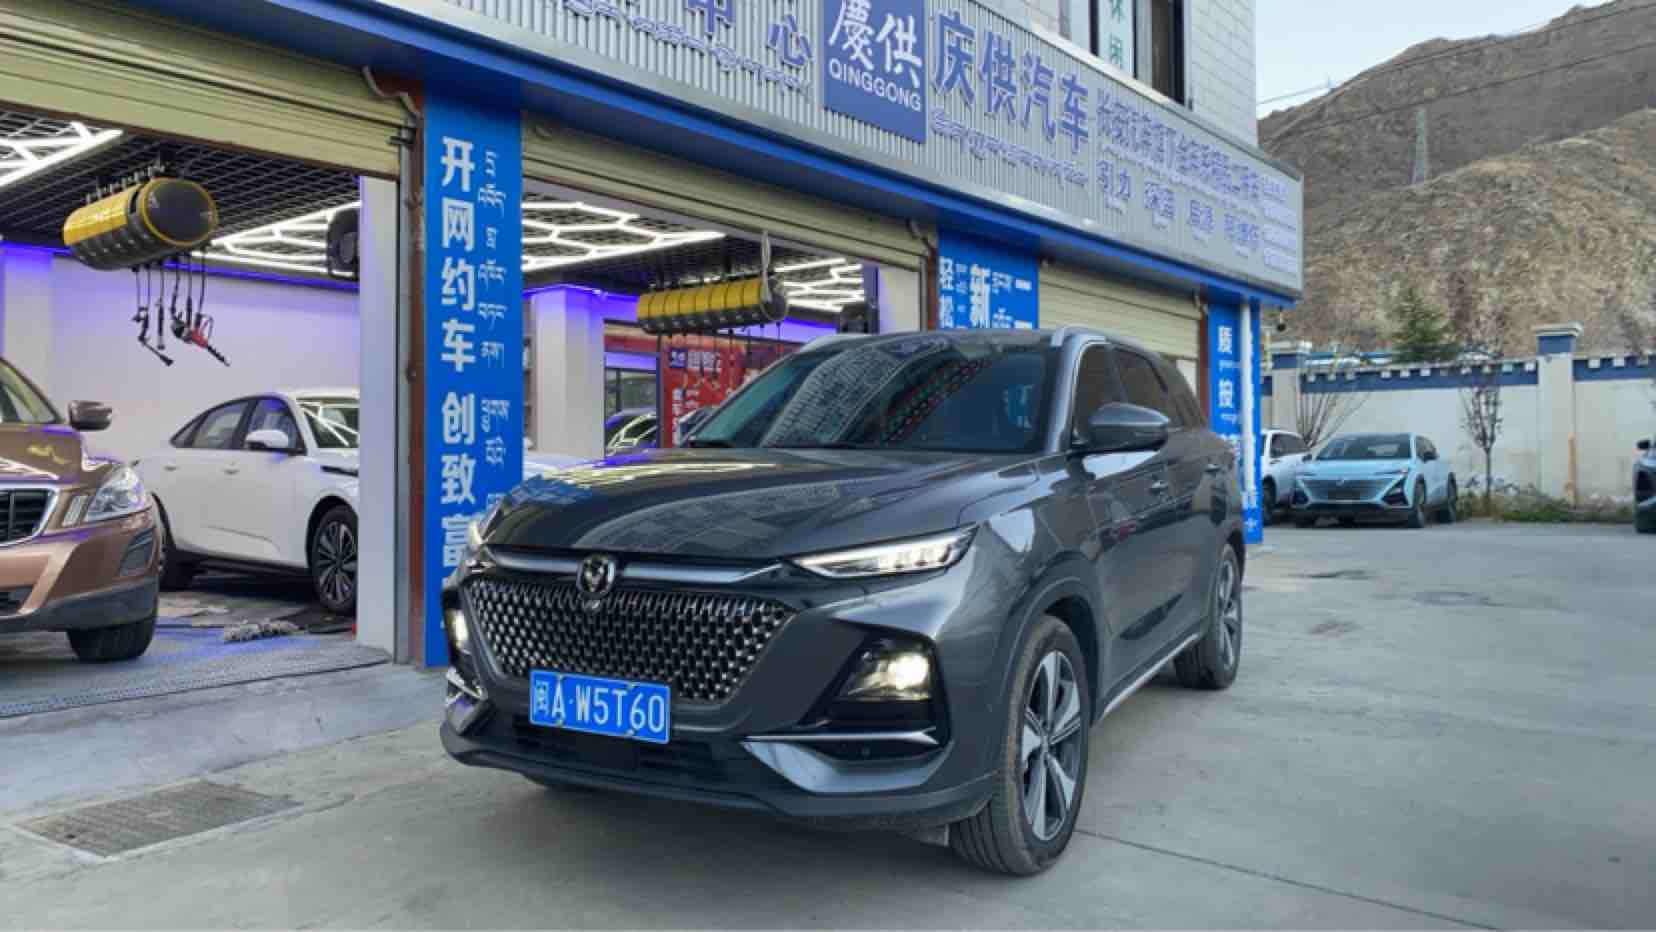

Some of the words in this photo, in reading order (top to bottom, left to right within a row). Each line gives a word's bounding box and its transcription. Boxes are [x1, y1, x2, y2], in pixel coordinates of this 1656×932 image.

[828, 57, 921, 112] QINGGONG
[933, 8, 1089, 154] 庆供汽车
[440, 135, 476, 373] 开网约车
